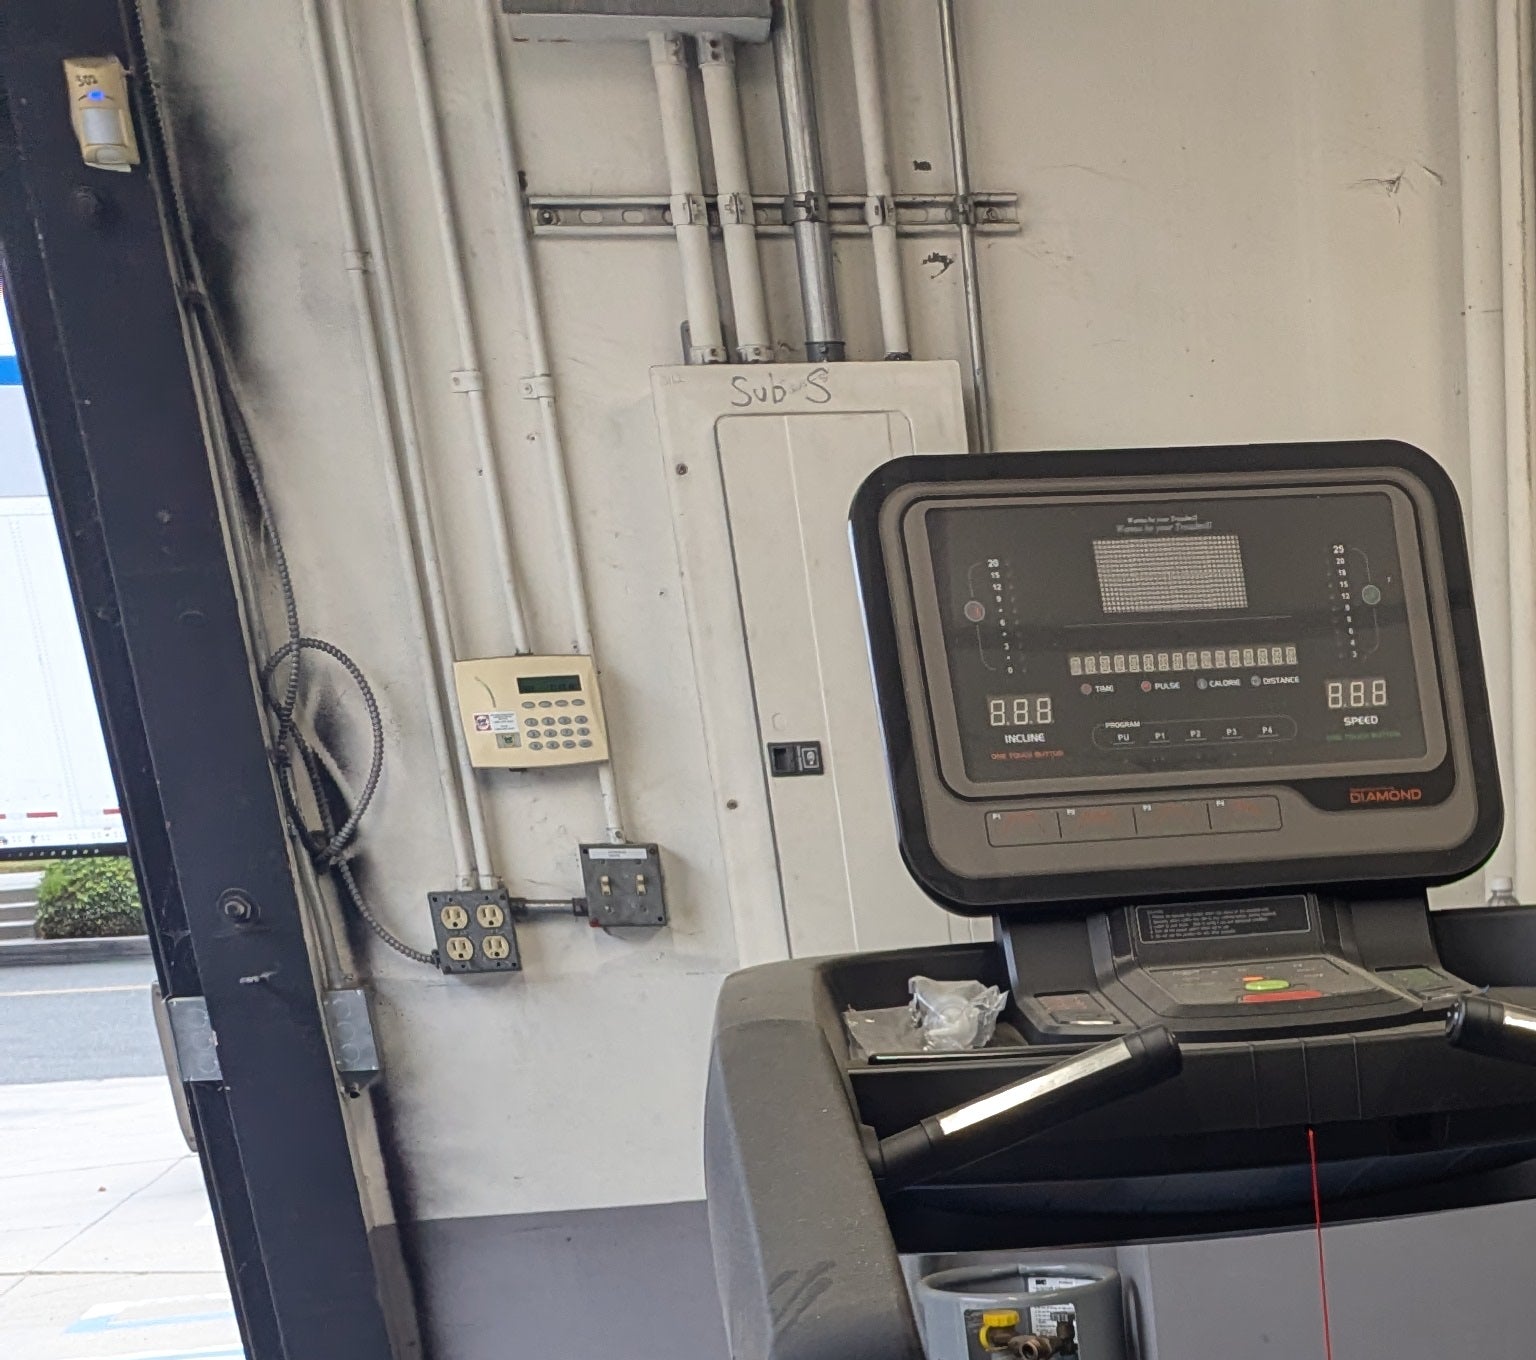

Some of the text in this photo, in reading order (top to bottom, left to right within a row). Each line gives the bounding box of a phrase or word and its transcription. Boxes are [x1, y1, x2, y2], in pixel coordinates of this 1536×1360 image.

[731, 372, 787, 407] Sub
[992, 583, 1002, 591] 12
[1154, 682, 1180, 690] PULSE
[1209, 678, 1241, 688] CALORIE
[1262, 675, 1300, 685] DISTANCE
[1104, 721, 1141, 729] PROGRAM
[1343, 715, 1379, 726] SPEED
[1004, 732, 1046, 744] INCLINE
[1155, 732, 1166, 740] P1
[1190, 730, 1201, 738] P2
[1226, 728, 1238, 736] P3
[1349, 788, 1422, 804] DIAMOND
